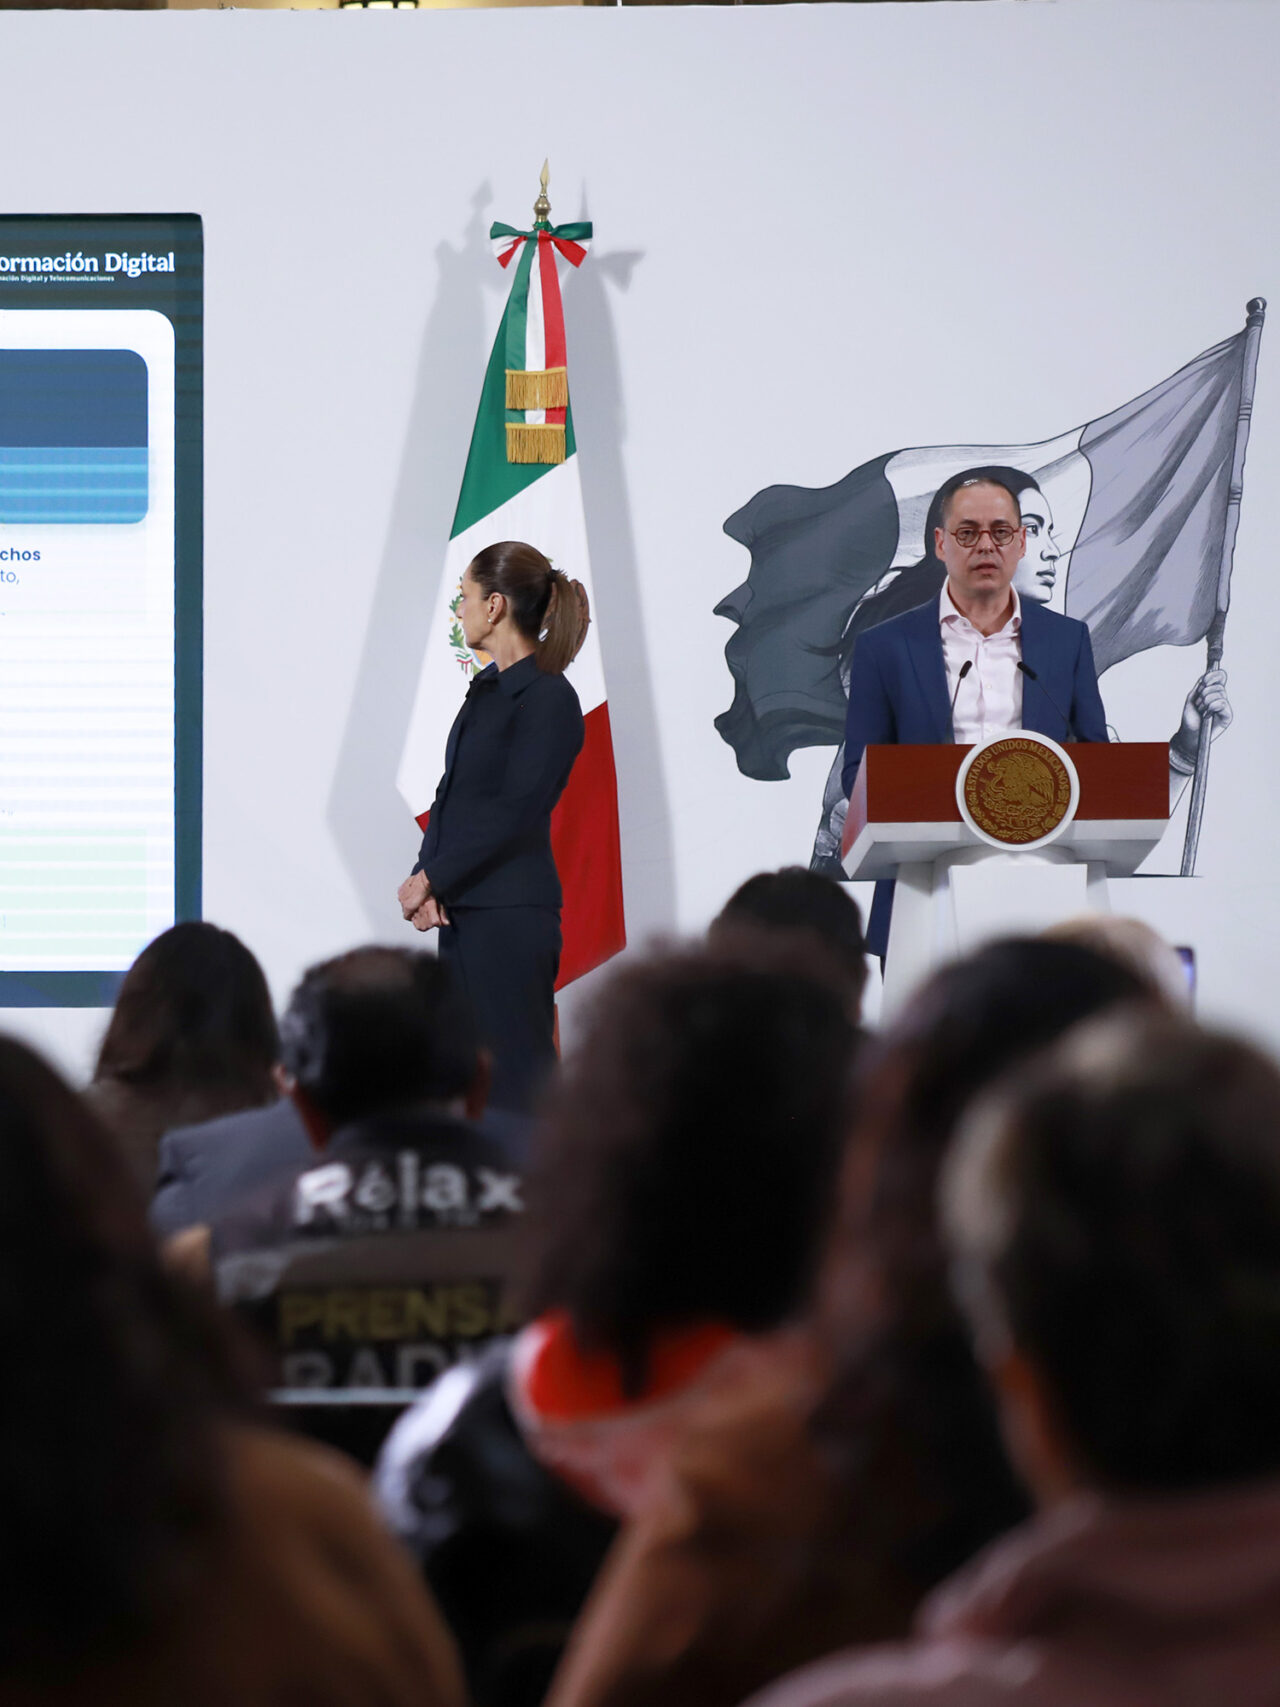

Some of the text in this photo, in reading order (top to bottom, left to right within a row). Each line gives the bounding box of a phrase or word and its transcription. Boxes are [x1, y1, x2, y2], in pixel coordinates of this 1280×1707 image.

[104, 252, 175, 278] Digital
[21, 274, 43, 283] Digital
[49, 274, 115, 282] Telecomunicaciones
[966, 740, 1069, 791] ESTADOS UNIDOS MEXICANOS
